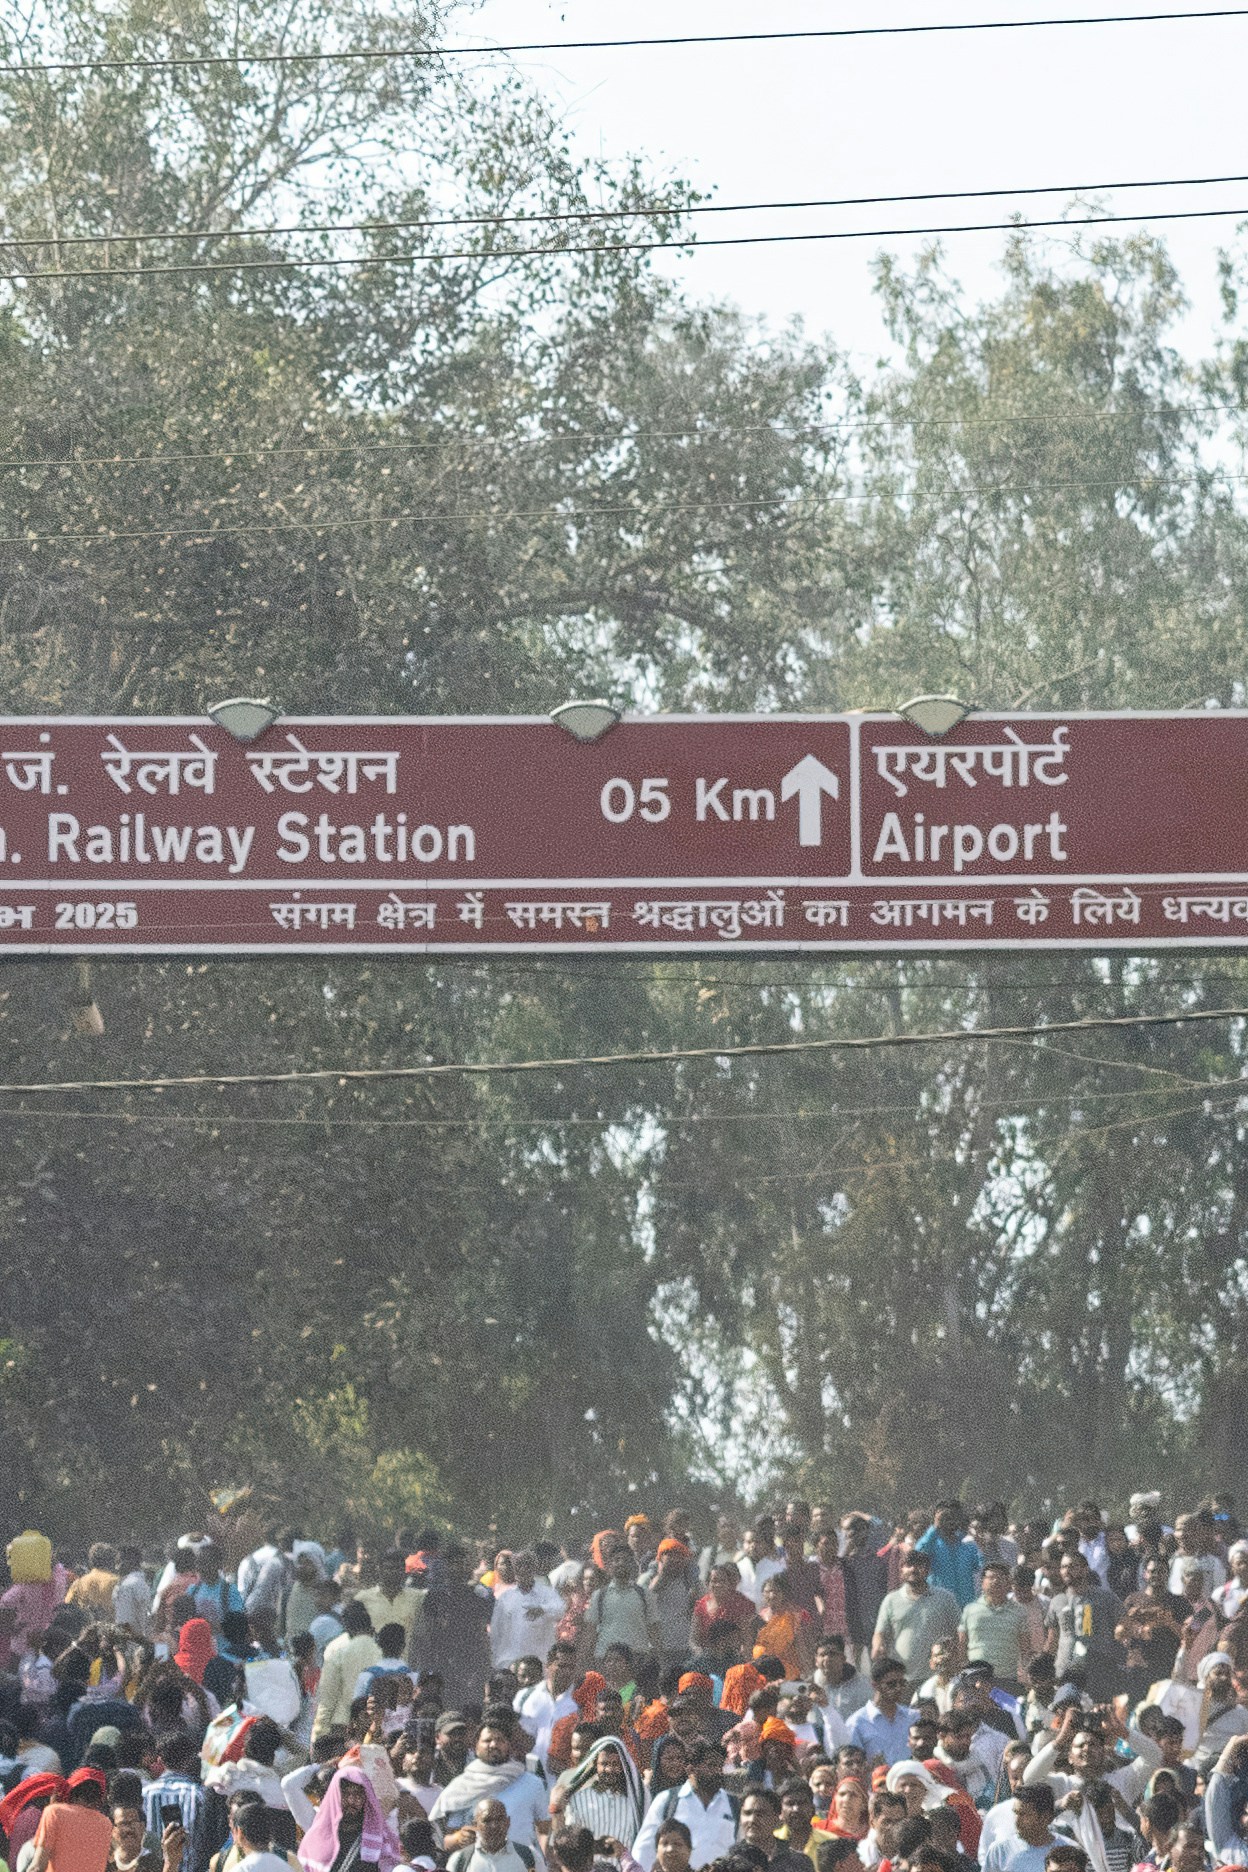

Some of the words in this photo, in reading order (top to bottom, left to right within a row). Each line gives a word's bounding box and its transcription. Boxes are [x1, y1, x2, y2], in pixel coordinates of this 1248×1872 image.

[2, 733, 68, 794] जं.
[101, 734, 218, 794] रेलवे
[245, 733, 400, 794] स्टेशन
[872, 726, 1070, 797] एयरपोर्ट
[601, 778, 670, 823] 05
[696, 778, 775, 821] Km
[49, 813, 255, 873] Railway
[277, 812, 475, 863] Station
[873, 812, 1067, 871] Airport
[55, 903, 138, 930] 2025
[269, 891, 356, 930] संगम
[377, 893, 436, 930] क्षेत्र
[456, 892, 485, 930] में
[632, 889, 785, 938] श्रद्धालुओं
[802, 901, 850, 926] का
[870, 900, 994, 926] आगमन
[1014, 888, 1050, 924] के
[1070, 887, 1141, 924] लिये
